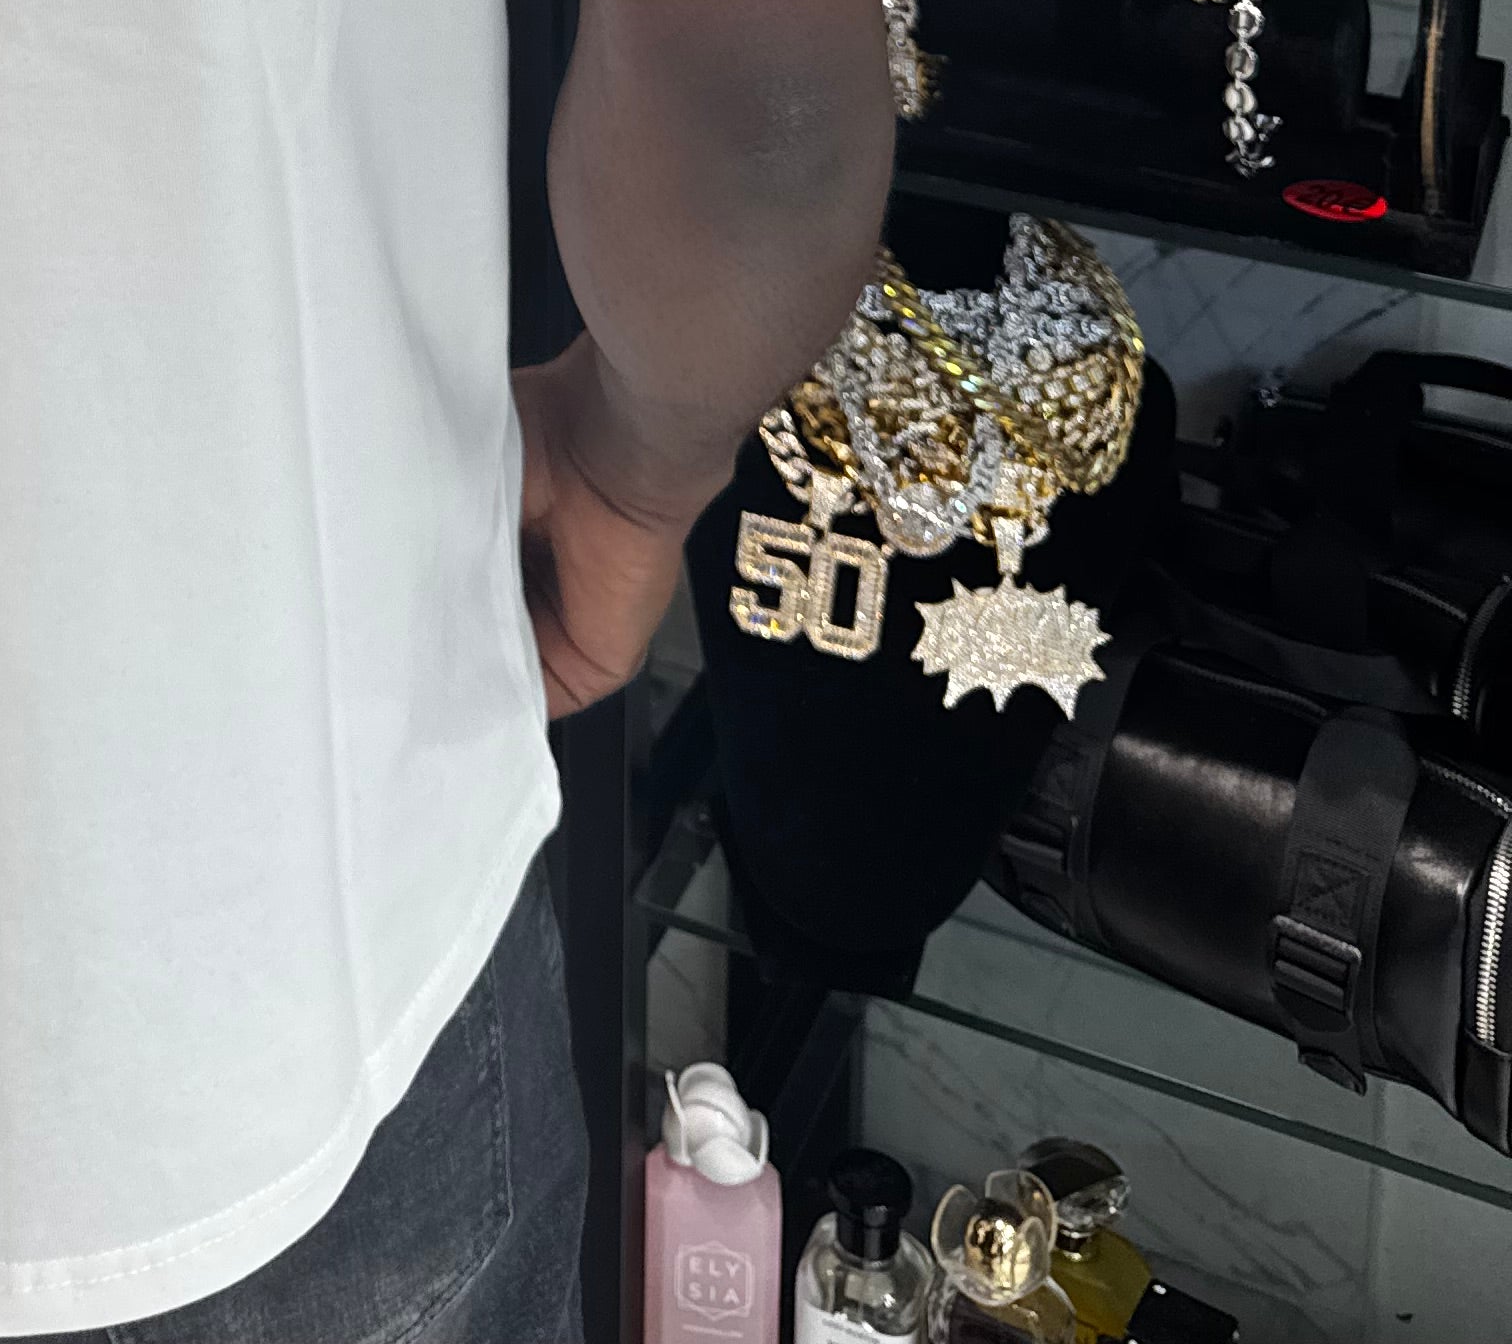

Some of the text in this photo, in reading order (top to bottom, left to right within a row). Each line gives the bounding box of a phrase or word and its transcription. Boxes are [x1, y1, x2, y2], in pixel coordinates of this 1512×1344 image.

[729, 510, 888, 662] 50
[689, 1255, 741, 1279] ELY
[688, 1281, 741, 1305] SIA
